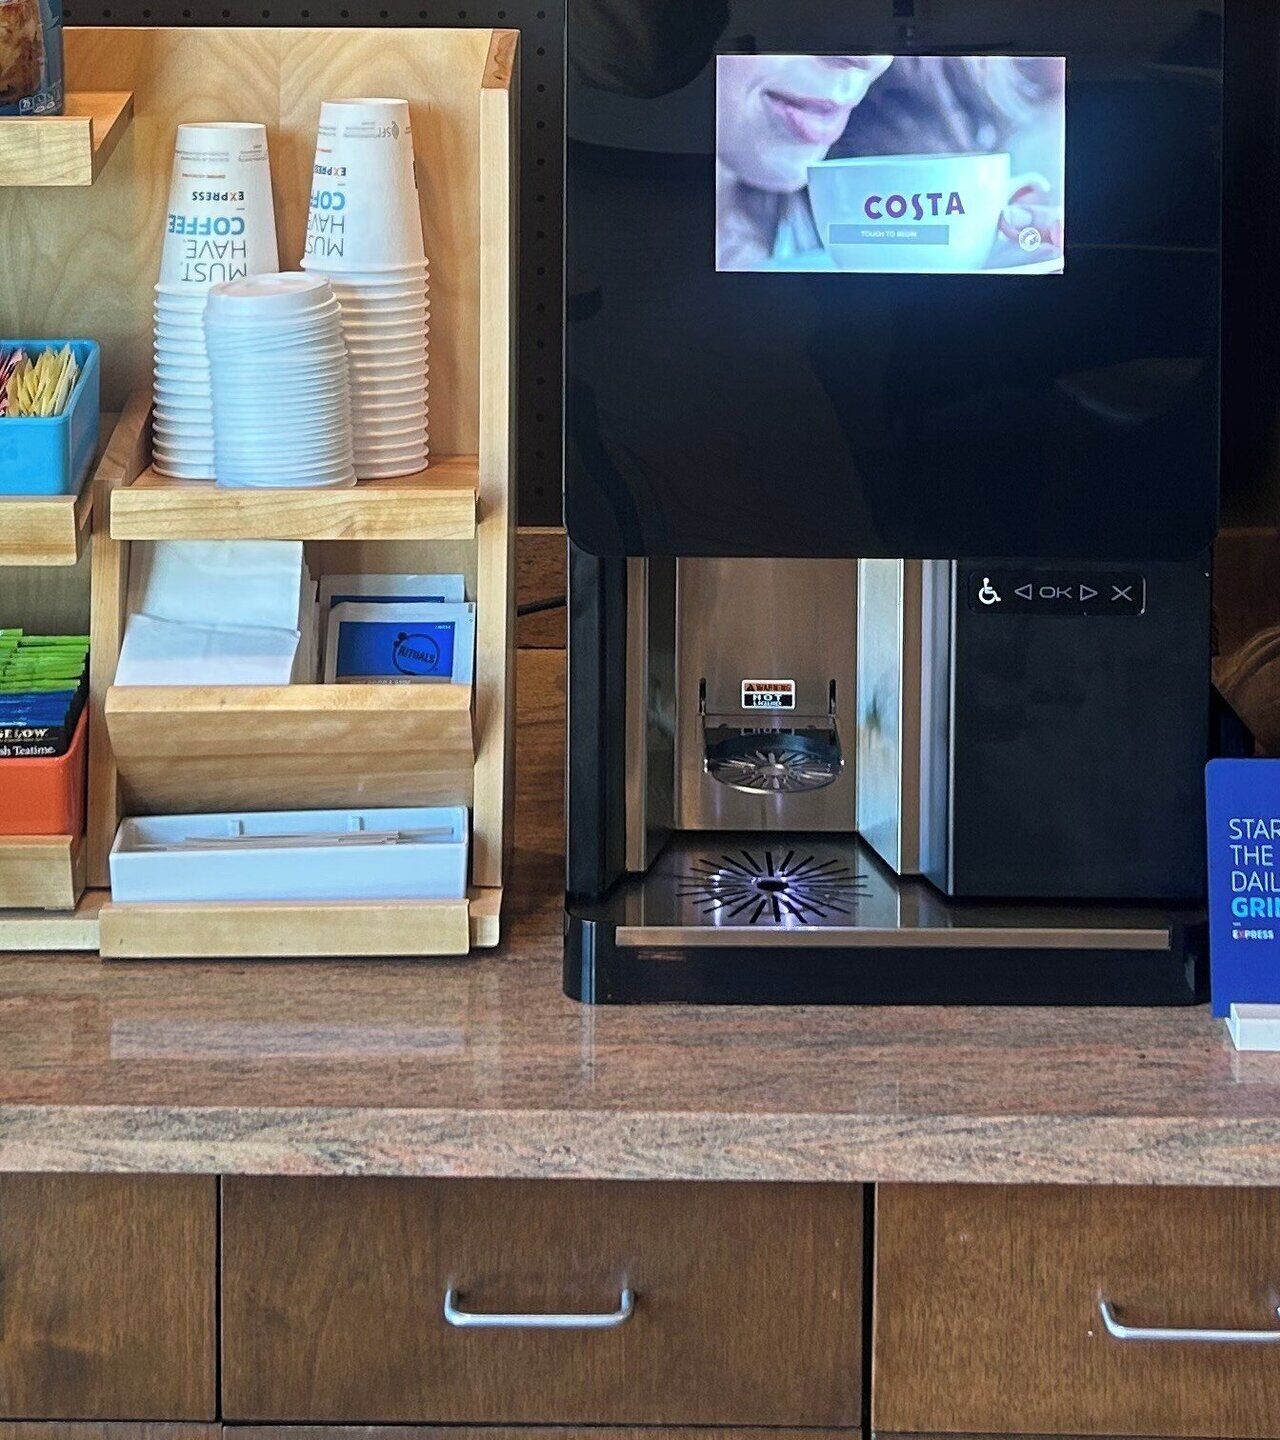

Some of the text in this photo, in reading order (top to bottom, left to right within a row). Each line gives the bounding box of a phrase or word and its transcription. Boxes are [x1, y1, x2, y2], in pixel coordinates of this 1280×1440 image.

[192, 191, 244, 201] EXPRESS
[310, 190, 346, 211] COF
[864, 191, 966, 221] COSTA
[309, 214, 345, 234] HAV
[305, 235, 344, 257] MUS
[1039, 586, 1072, 599] OK
[13, 745, 56, 757] Teatime
[1229, 844, 1274, 866] THE
[1232, 929, 1275, 940] EXPRESS
